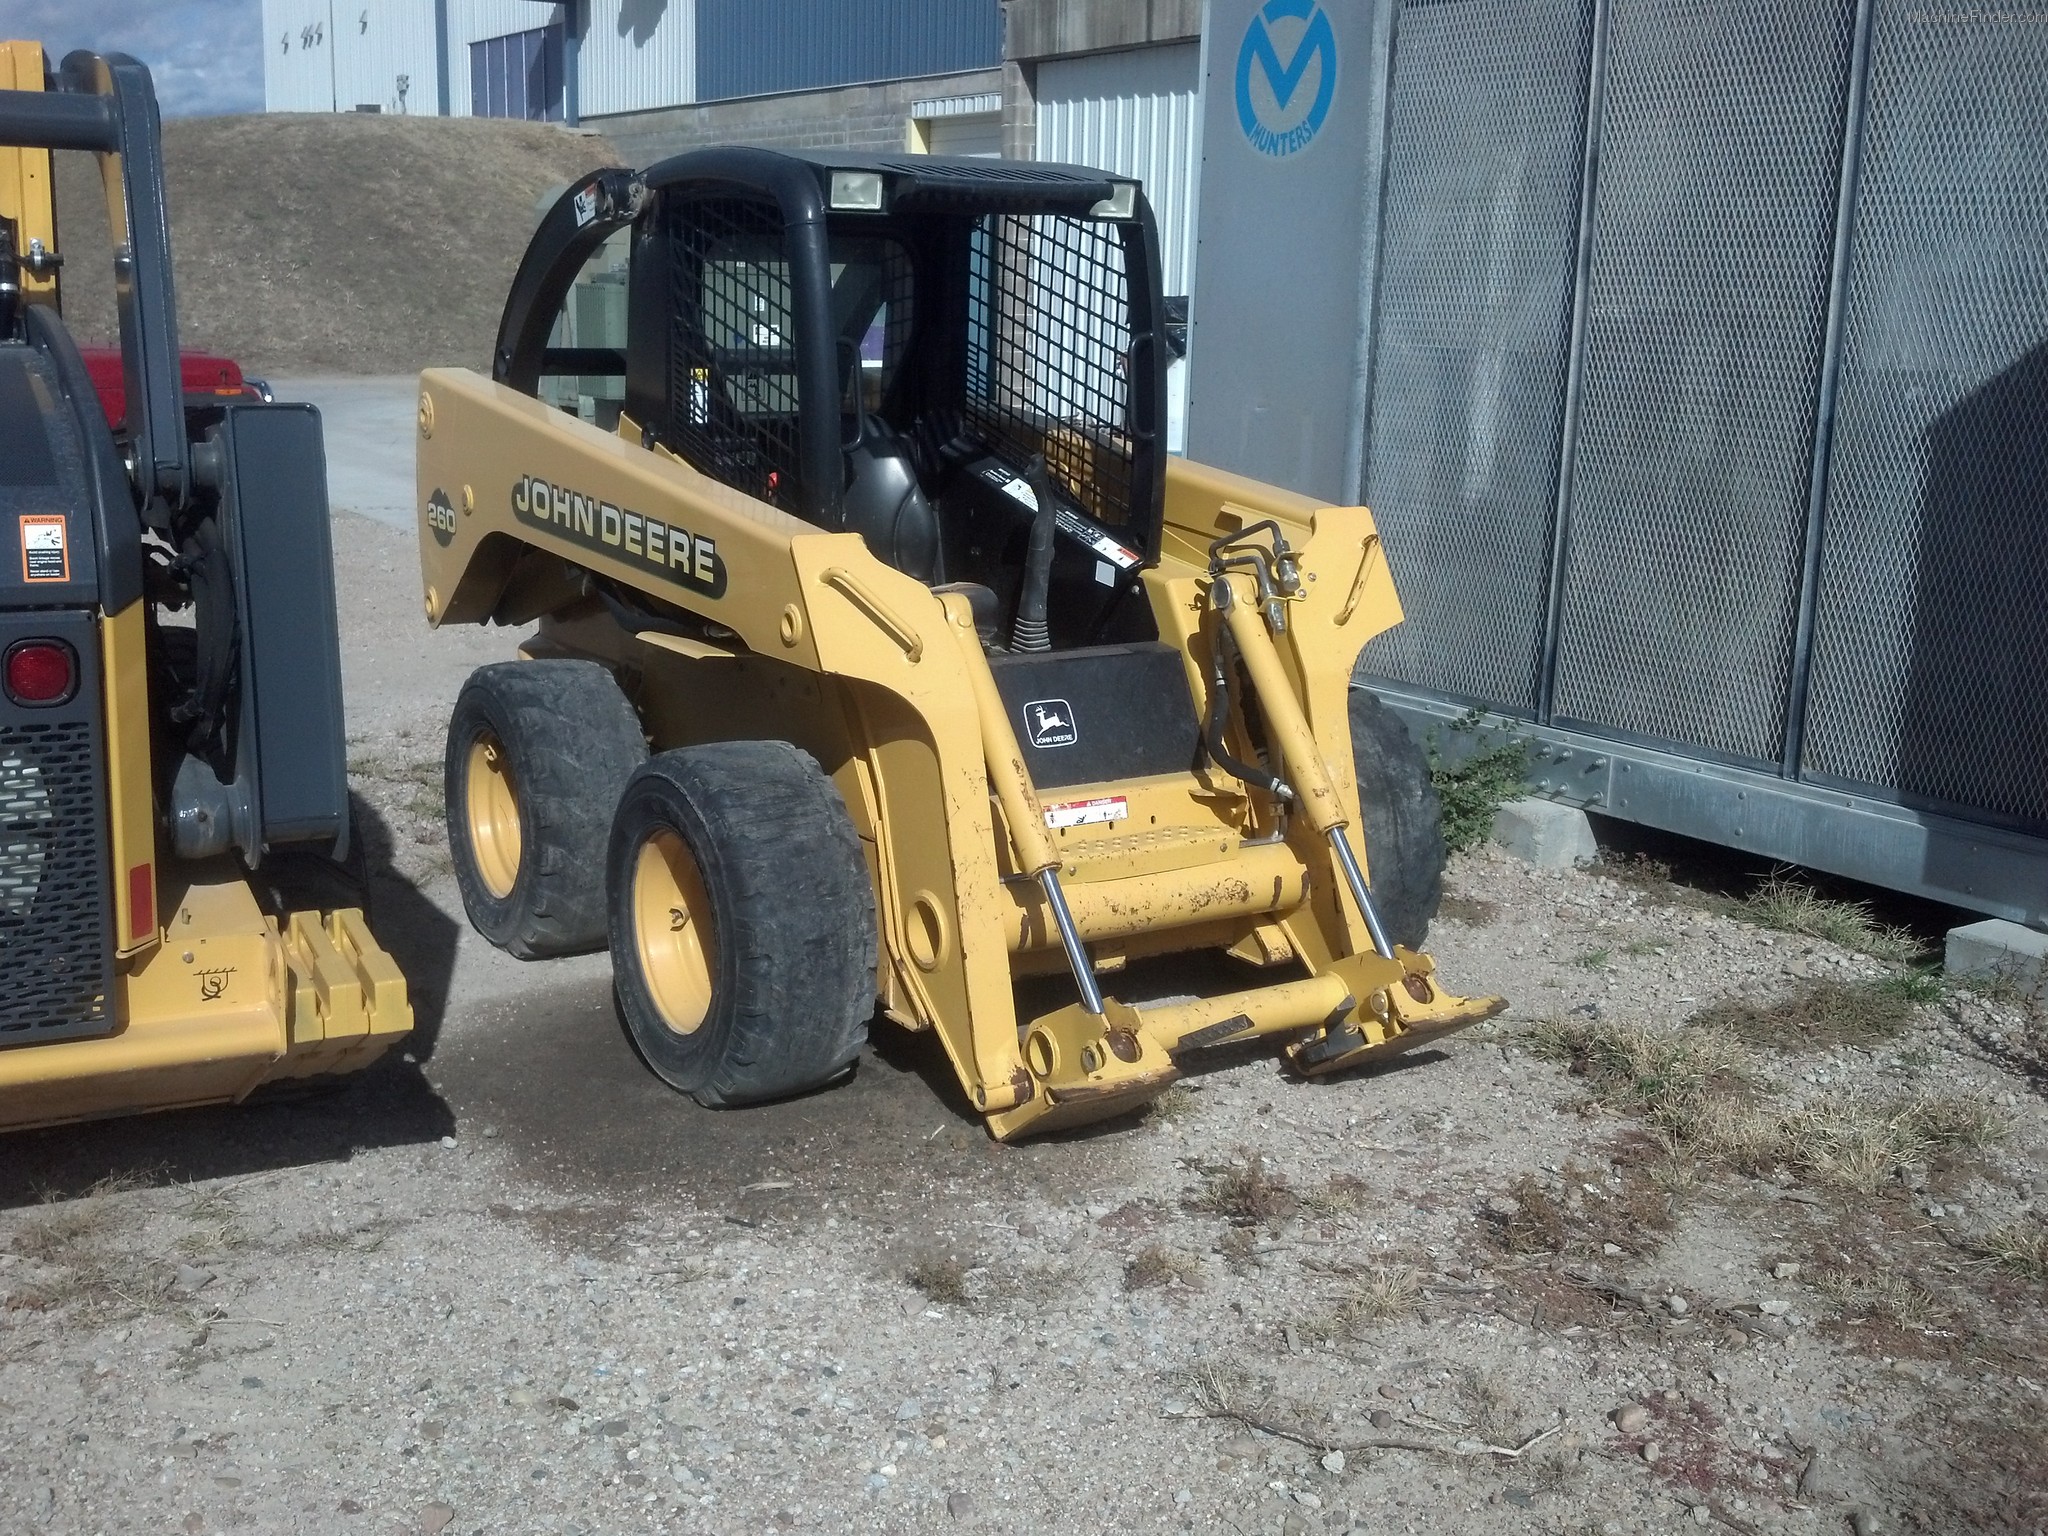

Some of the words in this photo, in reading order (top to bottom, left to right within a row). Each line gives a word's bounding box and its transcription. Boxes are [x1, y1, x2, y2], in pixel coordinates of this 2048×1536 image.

[1250, 120, 1313, 157] MUNTERS
[428, 502, 456, 533] 260
[516, 477, 594, 537] JOHN
[601, 504, 714, 584] DEERE
[1036, 736, 1053, 745] JOHN
[1053, 734, 1073, 743] DEERE
